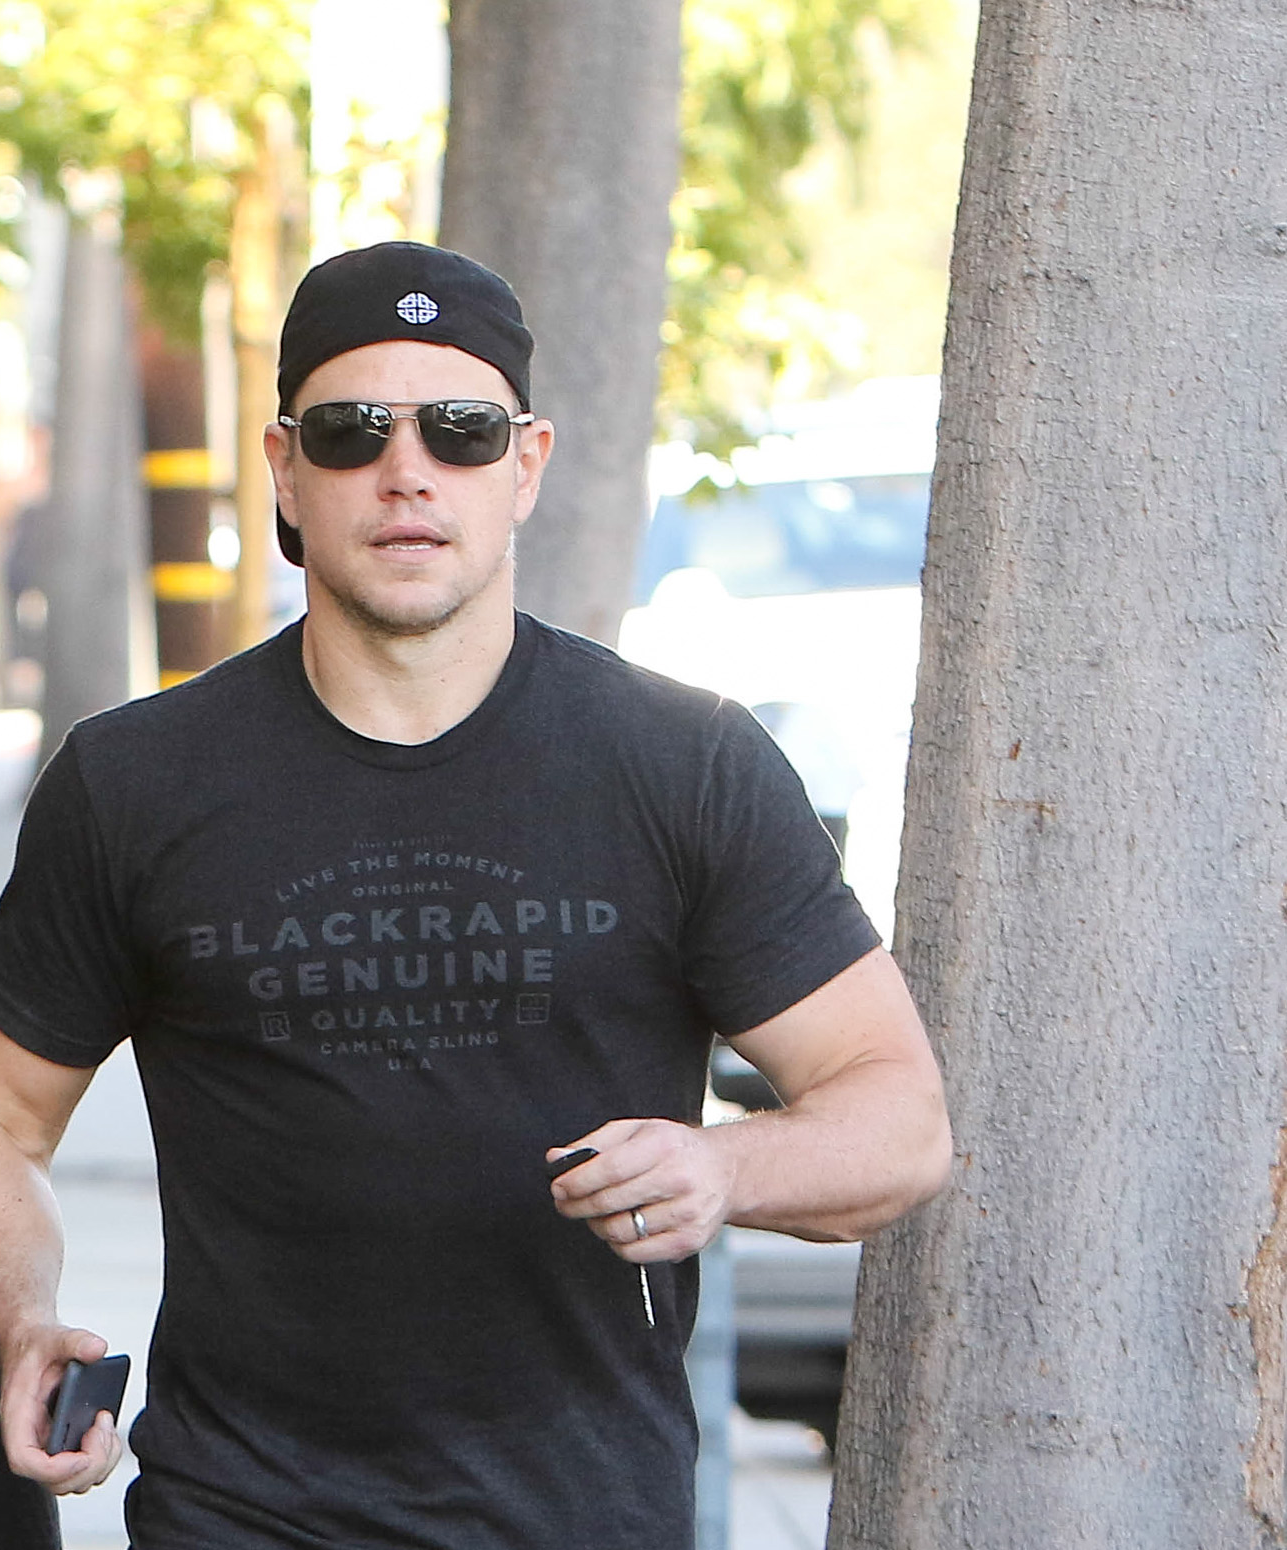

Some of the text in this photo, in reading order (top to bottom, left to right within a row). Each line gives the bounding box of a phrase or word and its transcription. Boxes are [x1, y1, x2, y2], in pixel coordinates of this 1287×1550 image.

[276, 852, 525, 902] LIVE THE MOMENT
[352, 881, 455, 898] ORIGINAL
[188, 899, 618, 959] BLACKRAPID
[249, 947, 554, 1000] GENUINE
[311, 998, 500, 1031] QUALITY
[429, 1032, 500, 1050] SLING
